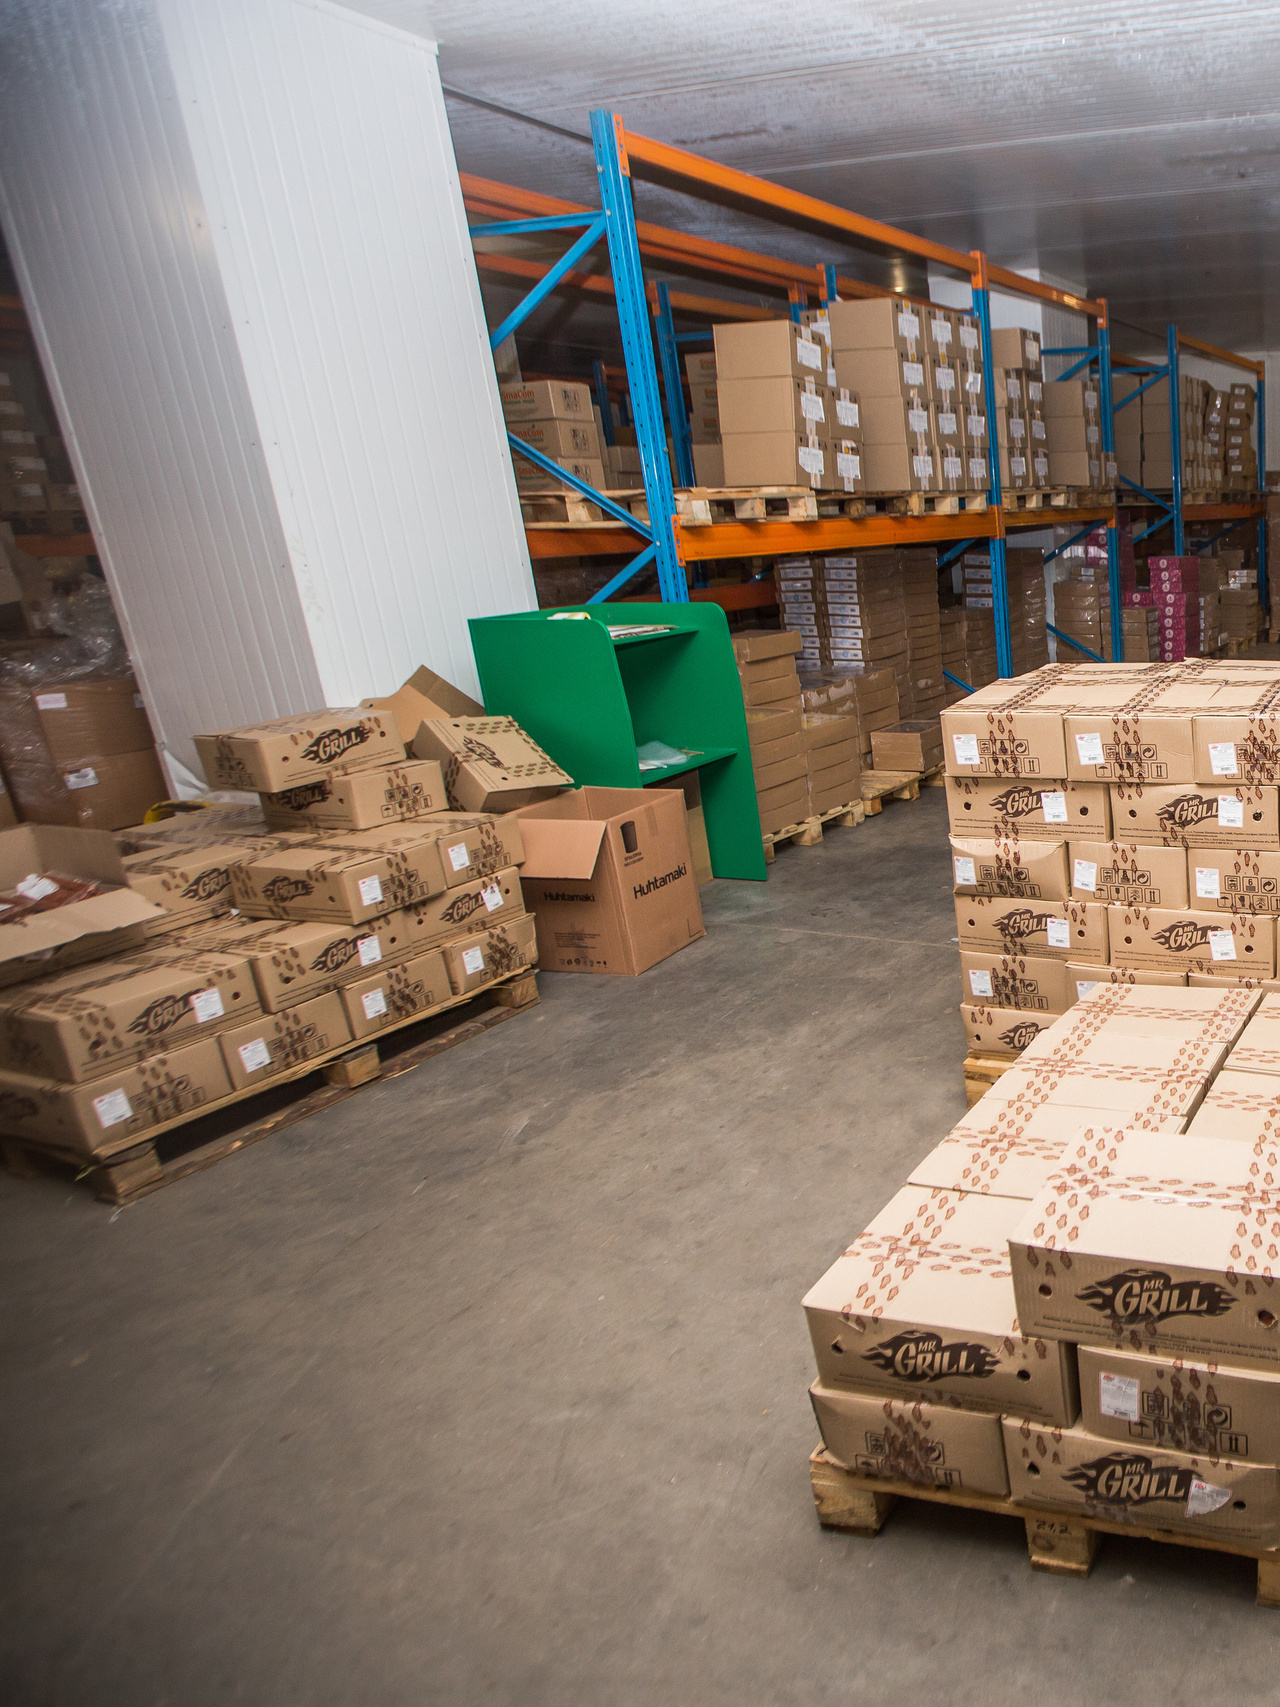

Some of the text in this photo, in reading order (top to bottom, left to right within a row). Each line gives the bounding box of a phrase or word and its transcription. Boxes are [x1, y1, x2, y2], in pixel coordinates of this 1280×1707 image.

[317, 731, 360, 762] GRILL
[1006, 792, 1043, 814] GRIL
[633, 862, 688, 900] Huhtamaki
[544, 891, 596, 903] Huhtamaki
[1144, 1279, 1164, 1290] MR
[1114, 1281, 1208, 1317] GRILL
[918, 1340, 937, 1352] MR
[894, 1342, 975, 1377] GRILL
[1125, 1462, 1145, 1474] MR
[1097, 1465, 1185, 1500] GRILL
